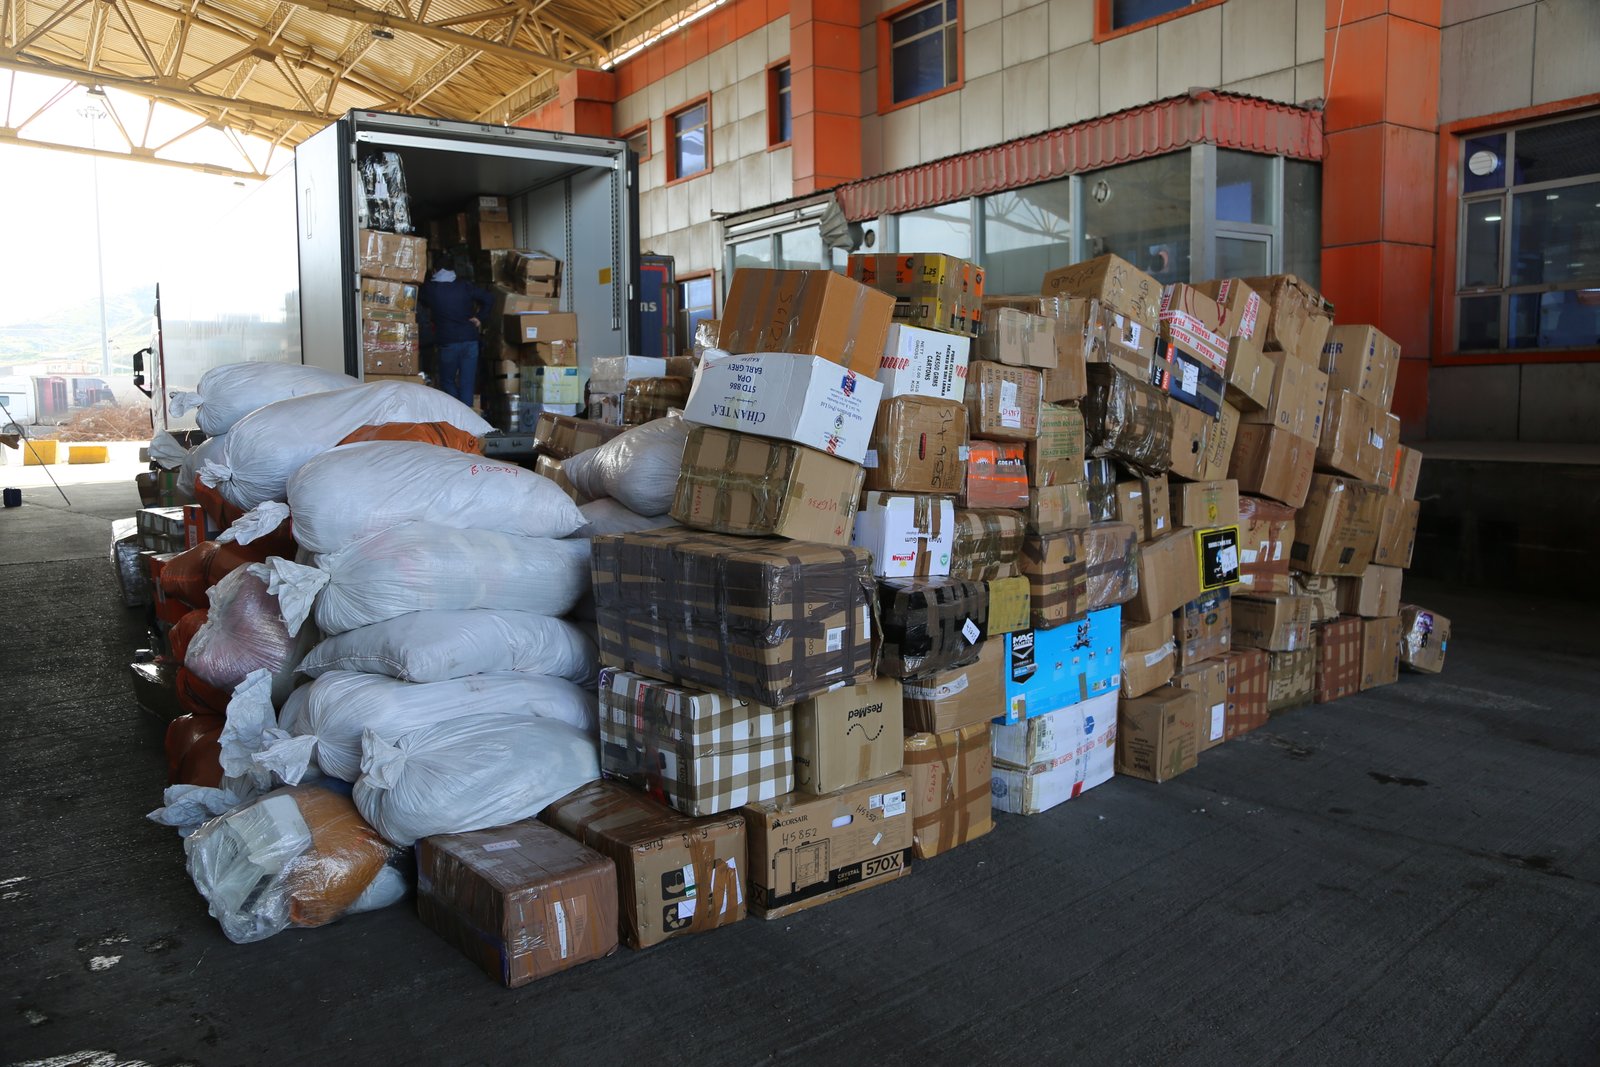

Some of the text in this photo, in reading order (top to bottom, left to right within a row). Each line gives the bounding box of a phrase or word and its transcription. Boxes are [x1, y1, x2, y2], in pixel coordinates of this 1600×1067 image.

[1190, 323, 1211, 340] FRAGILE
[1195, 341, 1215, 360] FRAGILE
[728, 364, 763, 375] EARL GREY
[924, 355, 933, 381] CARTONS
[737, 374, 752, 383] OPA
[729, 382, 757, 394] STD 886
[848, 702, 883, 722] ResMed
[781, 814, 808, 827] CORSAIR
[866, 854, 899, 876] 570X
[837, 868, 860, 879] CRYSTAL
